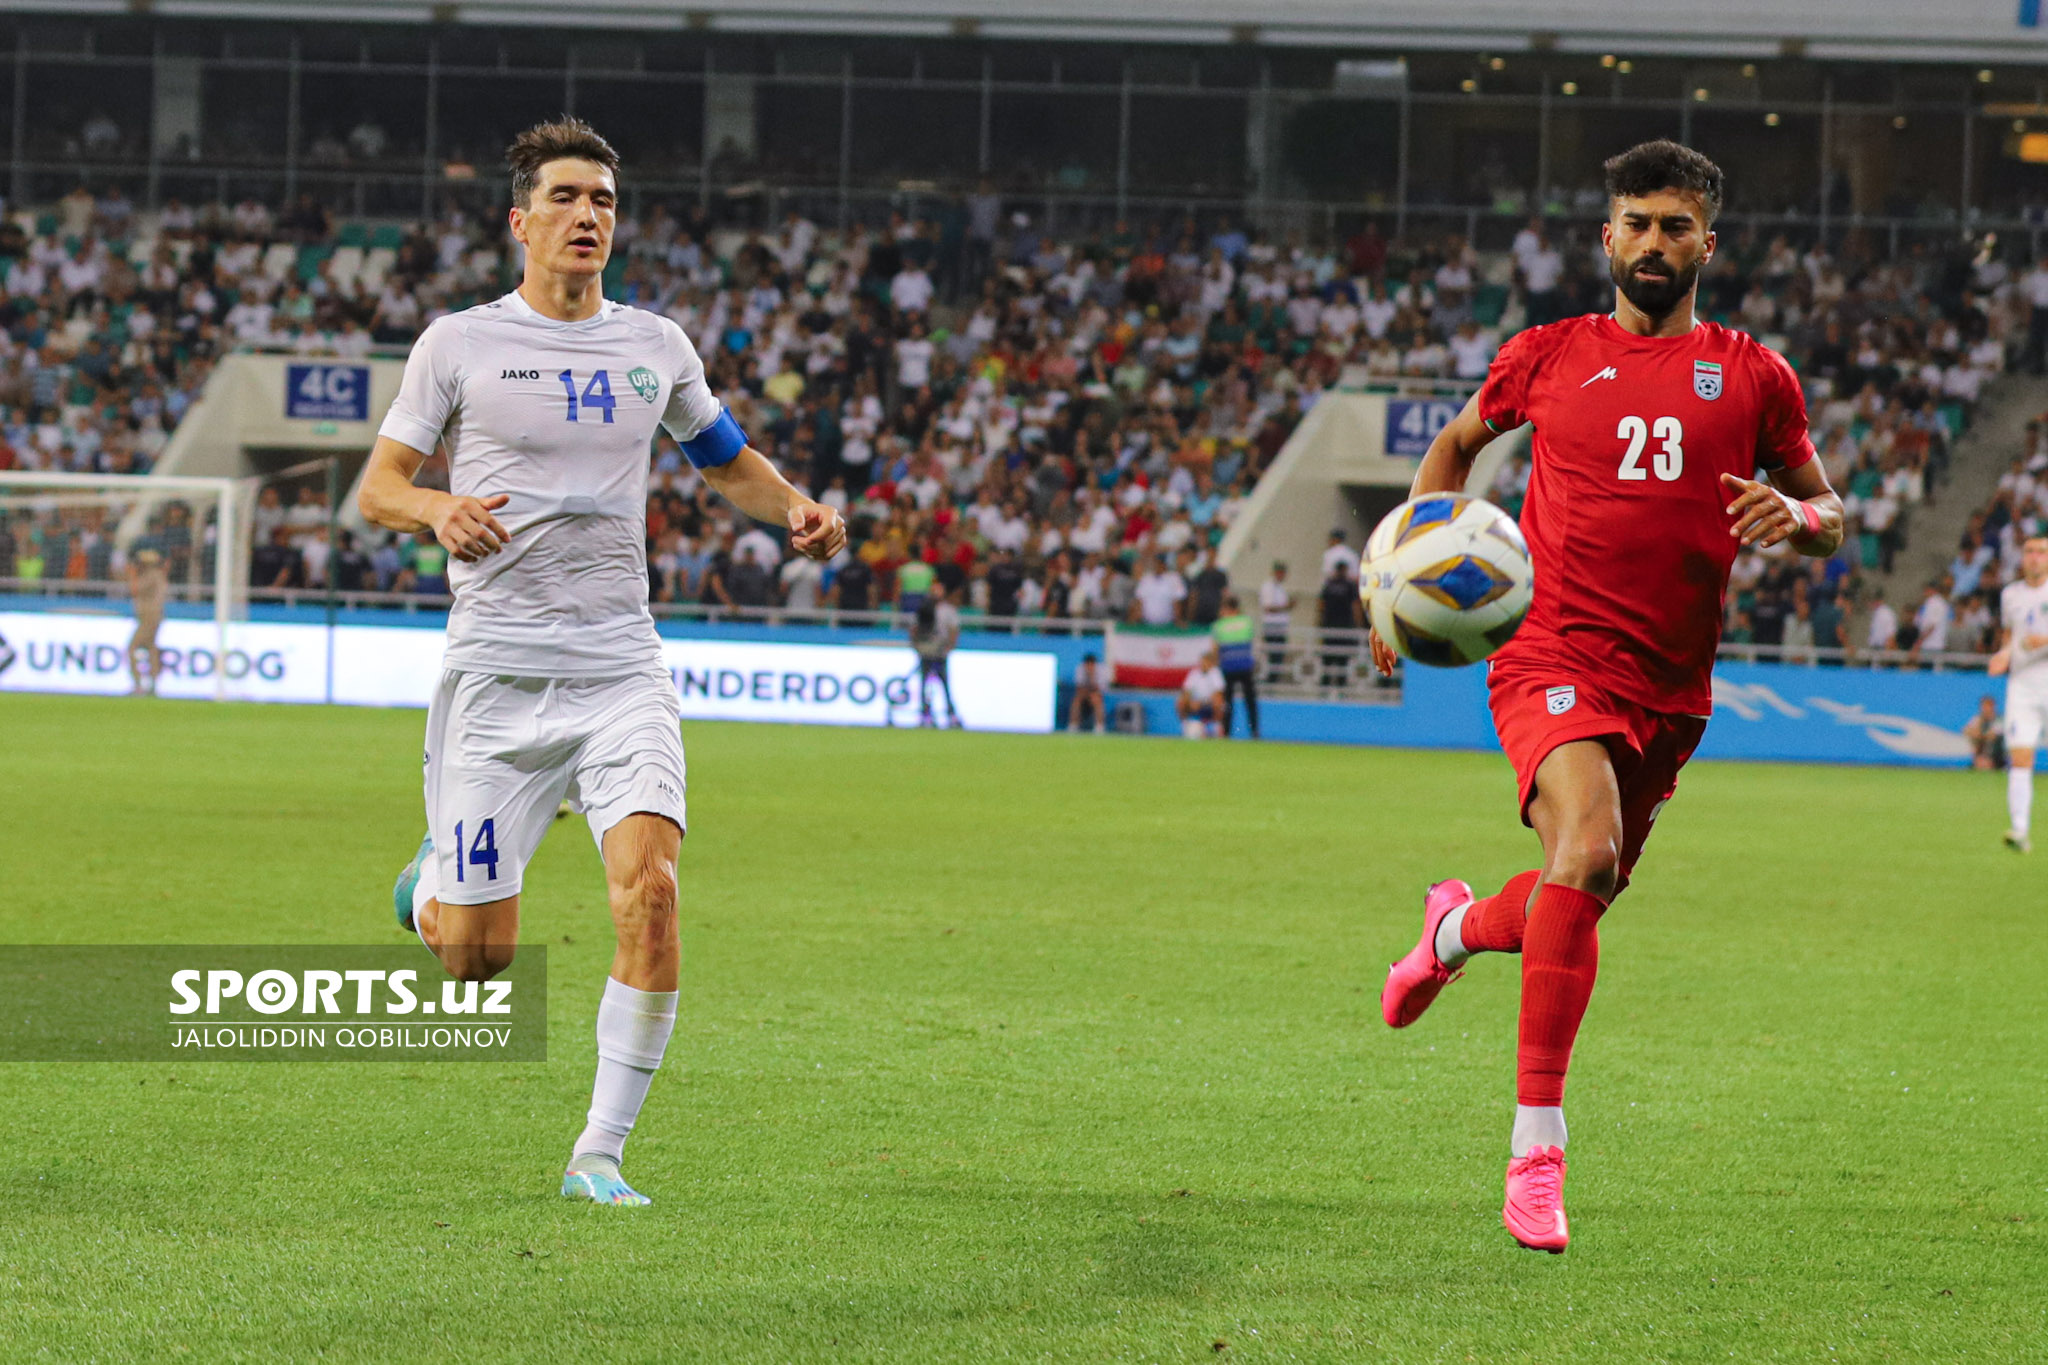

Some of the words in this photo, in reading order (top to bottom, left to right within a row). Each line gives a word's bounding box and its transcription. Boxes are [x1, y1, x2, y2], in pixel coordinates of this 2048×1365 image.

[300, 367, 355, 401] 4C
[500, 369, 540, 380] JAKO
[631, 372, 658, 388] UFA
[558, 369, 616, 423] 14
[1616, 415, 1683, 482] 23
[26, 641, 285, 681] UNDRDOG
[671, 667, 909, 706] NDERDOG
[454, 818, 498, 882] 14
